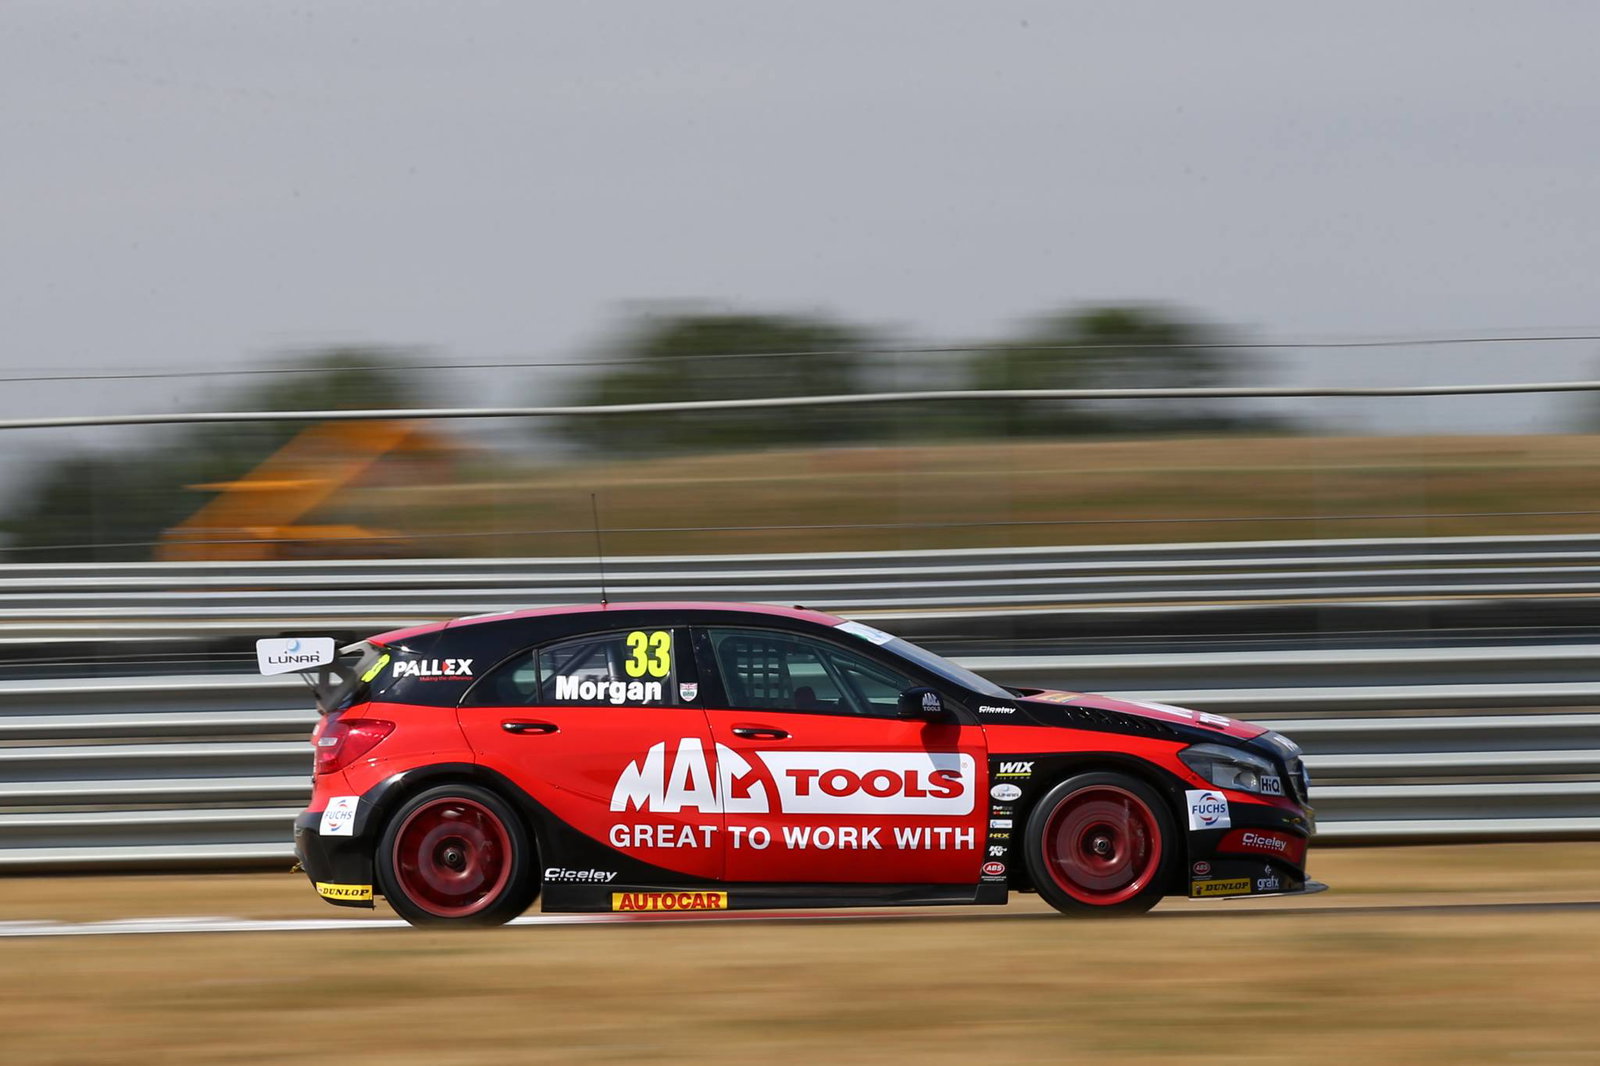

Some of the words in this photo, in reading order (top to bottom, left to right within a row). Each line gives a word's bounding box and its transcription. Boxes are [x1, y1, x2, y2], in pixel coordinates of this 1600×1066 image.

[268, 655, 320, 664] LUNAR
[625, 631, 671, 677] 33
[392, 659, 473, 677] PALLEX
[555, 675, 662, 705] Morgan
[1000, 761, 1034, 773] WIX
[609, 737, 770, 814] MAC
[785, 768, 965, 799] TOOLS
[1261, 778, 1280, 792] HiQ
[325, 810, 353, 820] FUCHS
[1192, 803, 1226, 815] FUCHS
[609, 823, 717, 849] GREAT
[728, 826, 771, 850] TO
[782, 826, 882, 850] WORK
[893, 826, 975, 850] WITH
[1242, 832, 1287, 851] Ciceley
[544, 867, 618, 882] Ciceley
[323, 887, 370, 896] DUNLOP
[1205, 881, 1249, 892] DUNLOP
[619, 892, 721, 910] AUTOCAR
